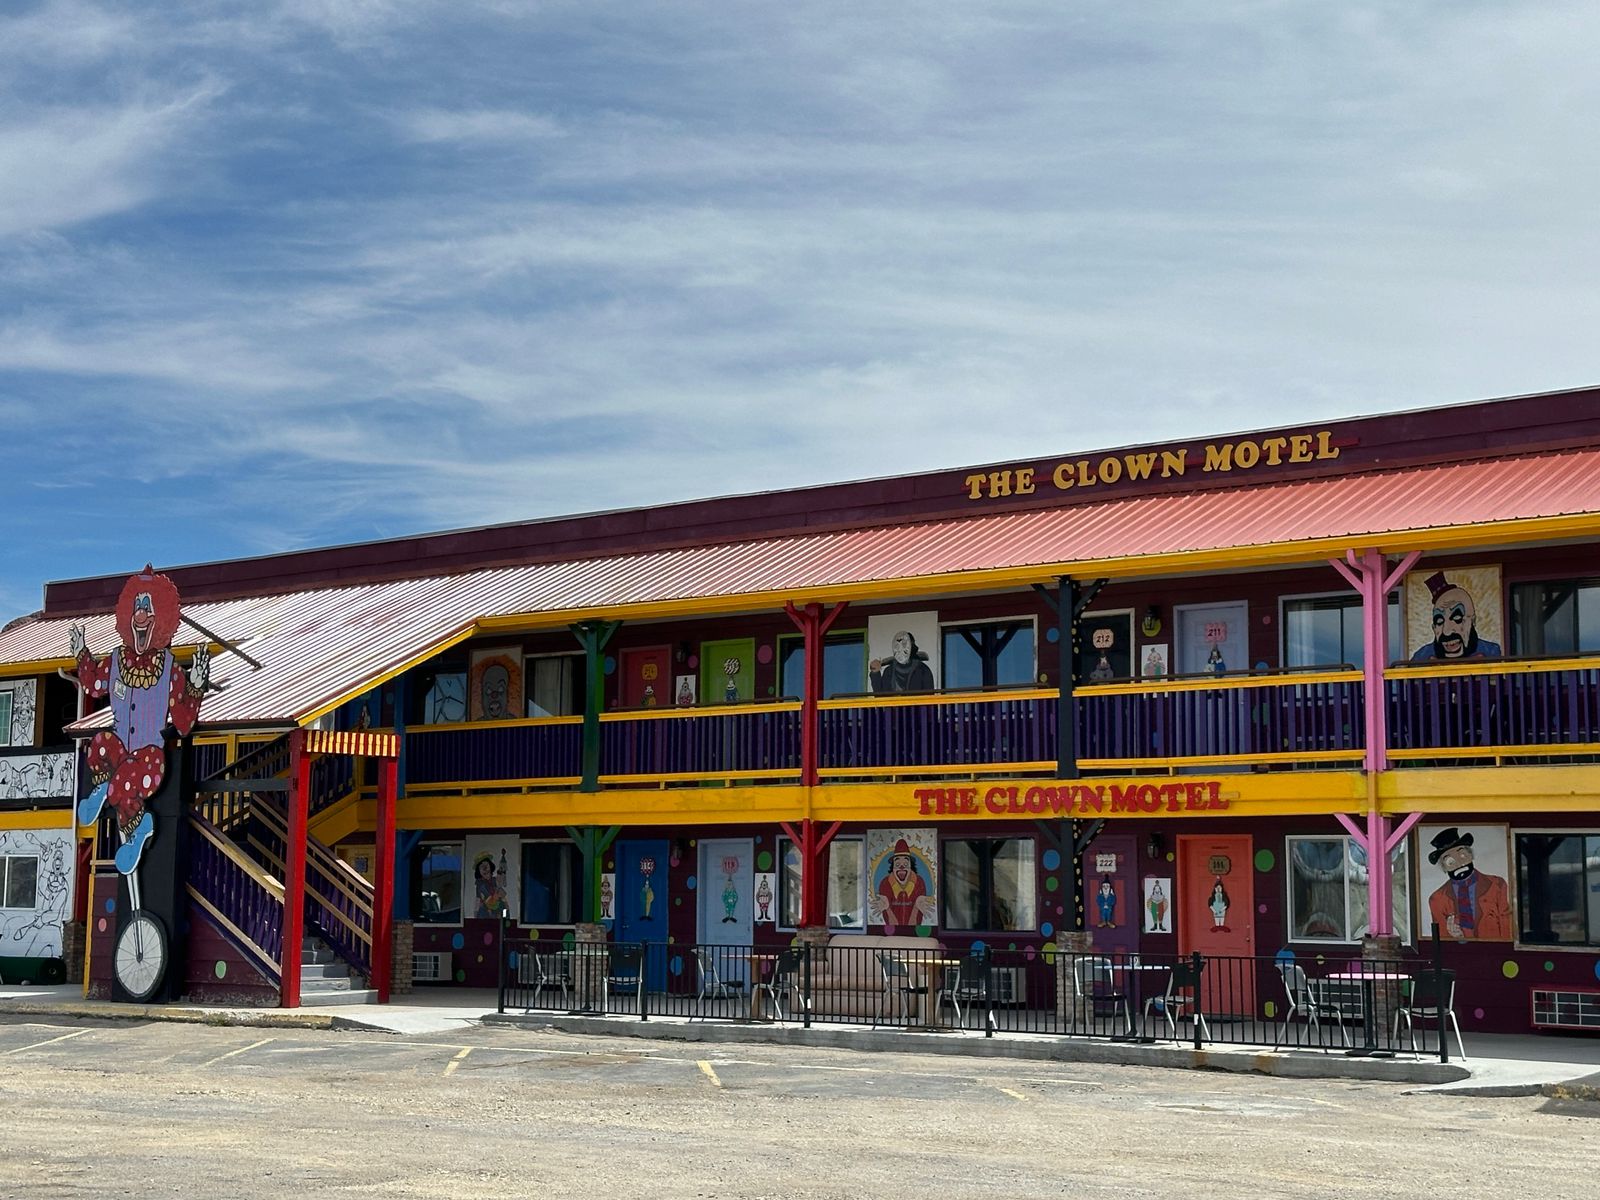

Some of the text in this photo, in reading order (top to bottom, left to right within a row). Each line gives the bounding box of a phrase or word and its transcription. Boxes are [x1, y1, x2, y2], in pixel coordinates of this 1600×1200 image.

[965, 431, 1340, 500] THE CLOWN MOTEL
[1096, 634, 1111, 643] 212
[1208, 628, 1221, 637] 211
[913, 781, 1230, 816] THE CLOWN MOTEL
